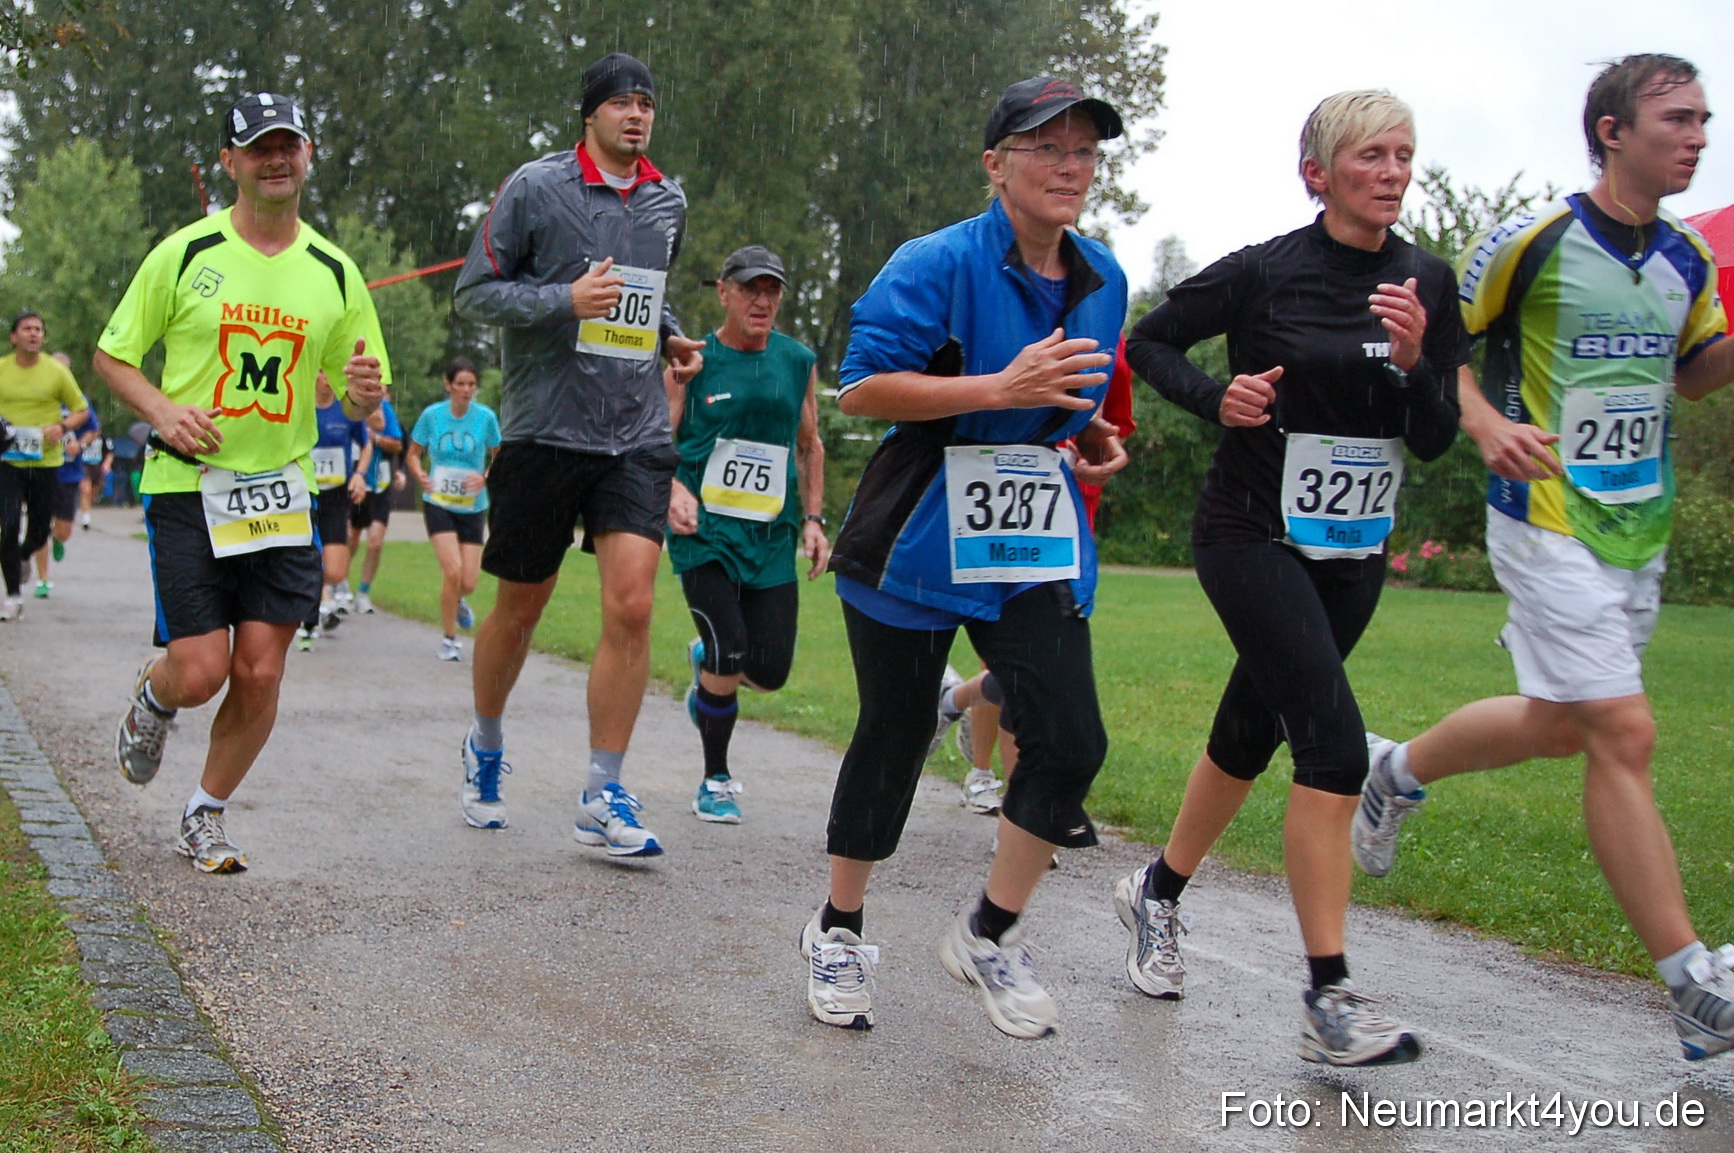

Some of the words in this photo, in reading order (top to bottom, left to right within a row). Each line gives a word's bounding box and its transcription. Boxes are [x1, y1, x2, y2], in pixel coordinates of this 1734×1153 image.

[221, 302, 309, 331] Müller
[604, 329, 643, 347] Thomas
[236, 352, 282, 395] M
[1332, 445, 1383, 459] BOCK
[1574, 415, 1659, 460] 2497
[722, 459, 772, 492] 675
[1296, 468, 1394, 515] 3212
[227, 480, 292, 516] 459
[965, 479, 1062, 532] 3287
[248, 519, 281, 537] Mike
[988, 542, 1041, 562] Mane
